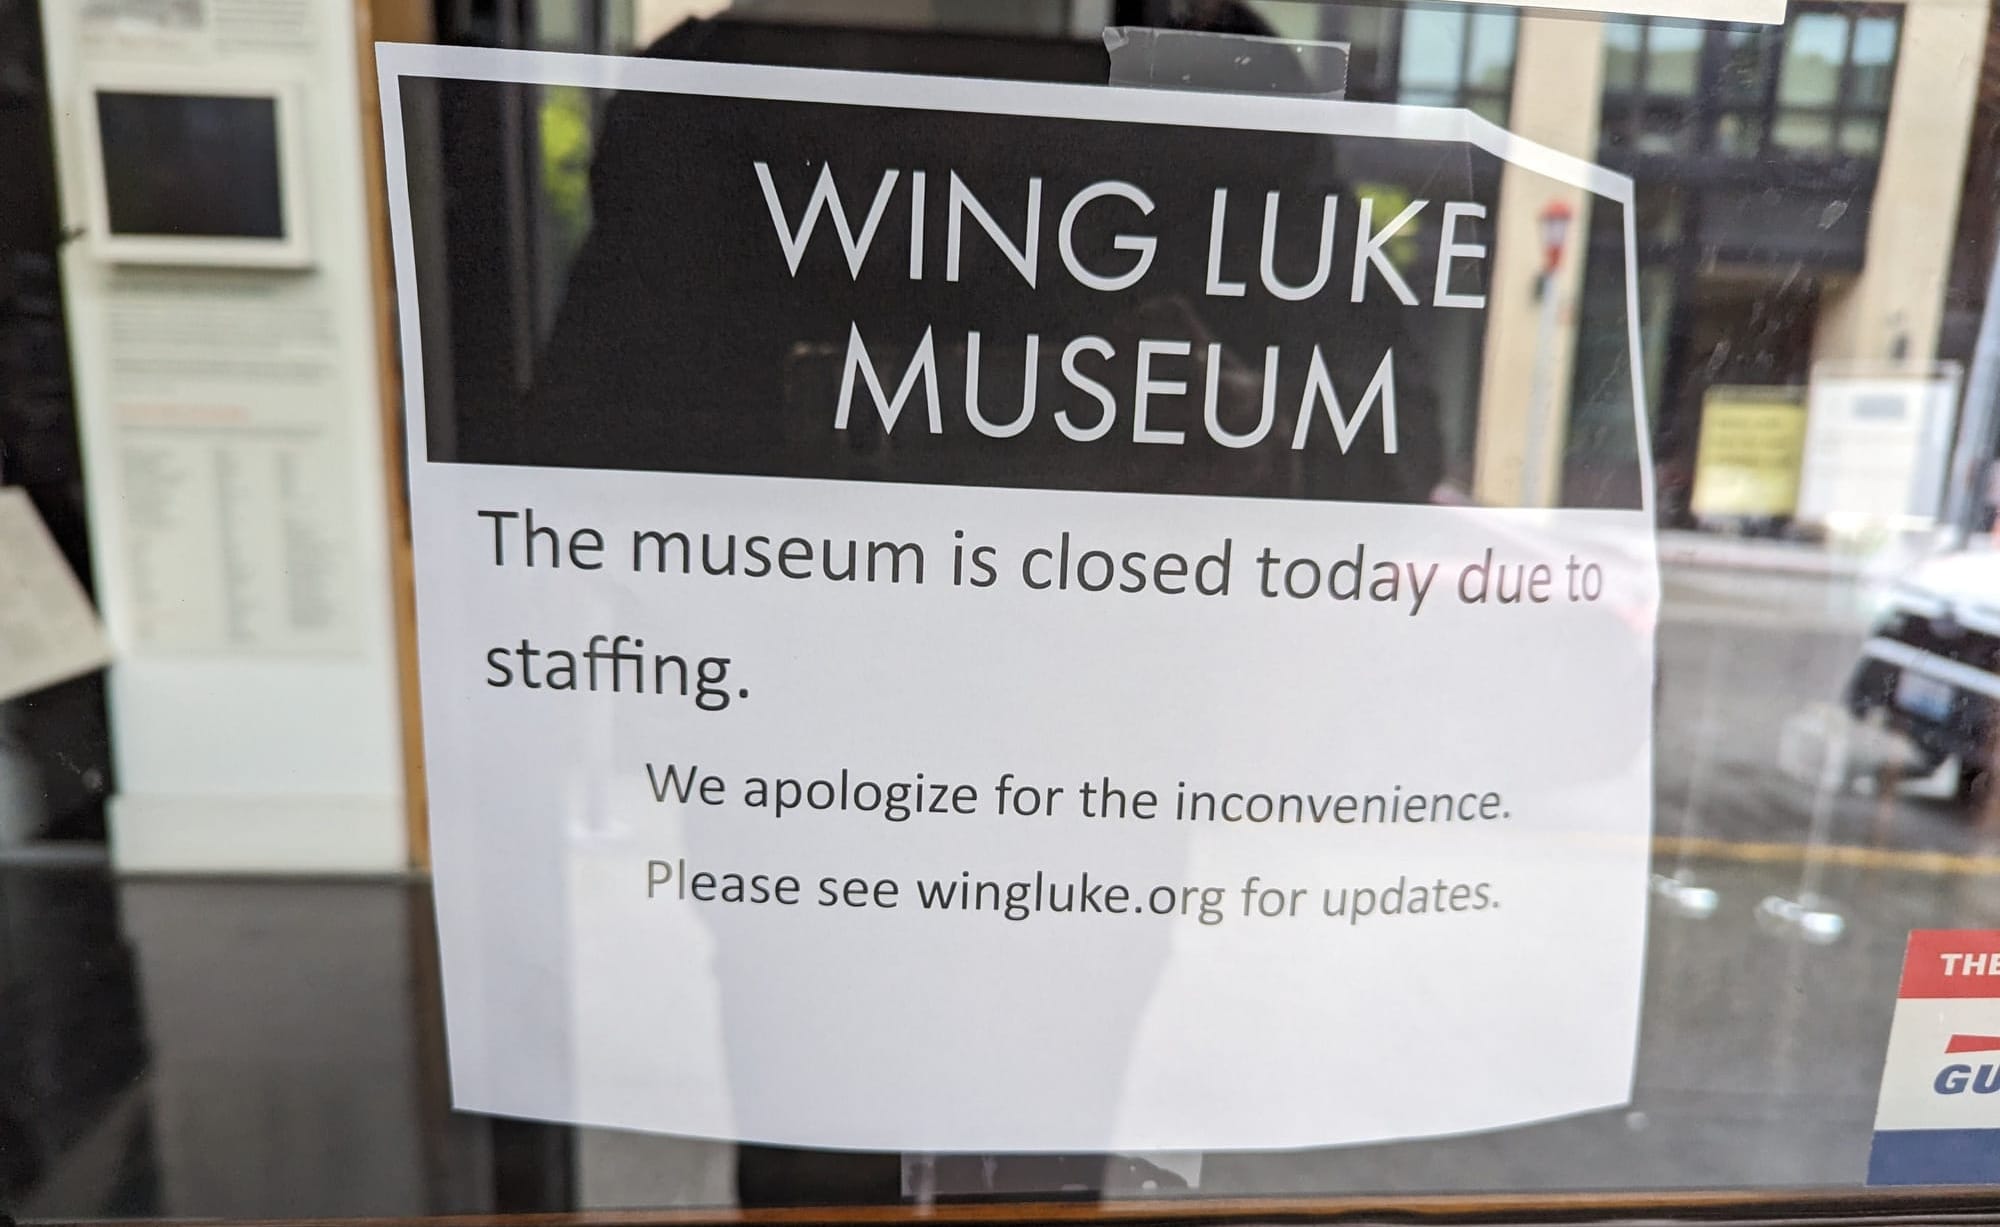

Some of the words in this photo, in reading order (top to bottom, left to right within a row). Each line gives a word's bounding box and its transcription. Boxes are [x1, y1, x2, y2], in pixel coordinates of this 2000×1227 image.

[754, 162, 1157, 291] WING
[1205, 189, 1487, 308] LUKE
[835, 321, 1397, 454] MUSEUM
[478, 508, 604, 570] The
[634, 531, 924, 584] museum
[954, 530, 997, 587] is
[1023, 532, 1232, 596] closed
[1256, 544, 1438, 616] today
[1459, 548, 1550, 604] due
[1566, 555, 1602, 602] to
[487, 635, 748, 711] staffing.
[646, 763, 725, 805] We
[744, 768, 977, 822] apologize
[995, 774, 1064, 816] for
[1079, 777, 1157, 819] the
[1177, 782, 1509, 823] inconvenience.
[649, 859, 800, 905] Please
[818, 878, 898, 908] see
[917, 871, 1225, 925] wingluke.org
[1241, 877, 1306, 917] for
[1324, 876, 1498, 923] updates.
